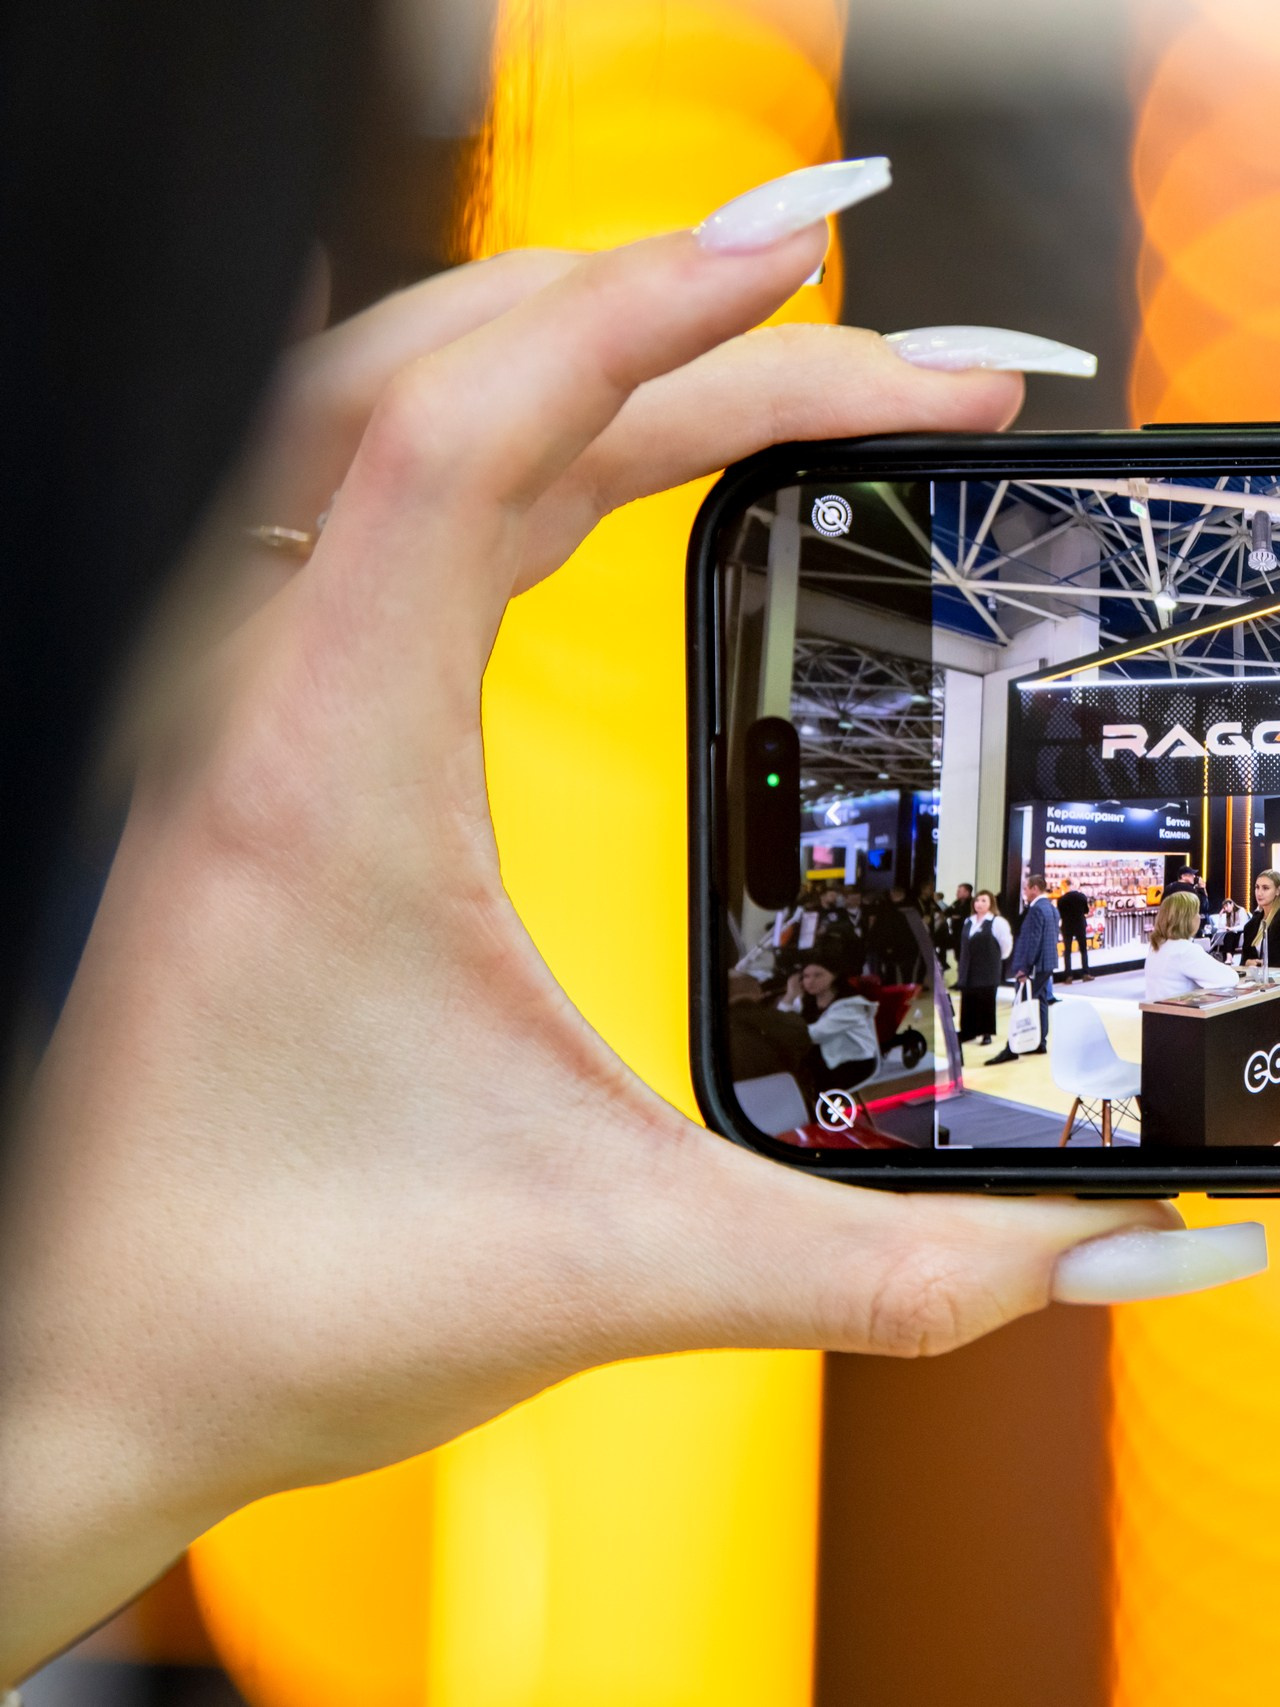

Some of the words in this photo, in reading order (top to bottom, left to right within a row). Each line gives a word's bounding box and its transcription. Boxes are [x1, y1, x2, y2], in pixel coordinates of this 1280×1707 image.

[1047, 806, 1126, 823] Керамогранит
[1046, 821, 1087, 835] Плитка
[1166, 816, 1191, 827] Бетон
[1159, 828, 1191, 839] Камень
[1045, 836, 1087, 849] Стекло
